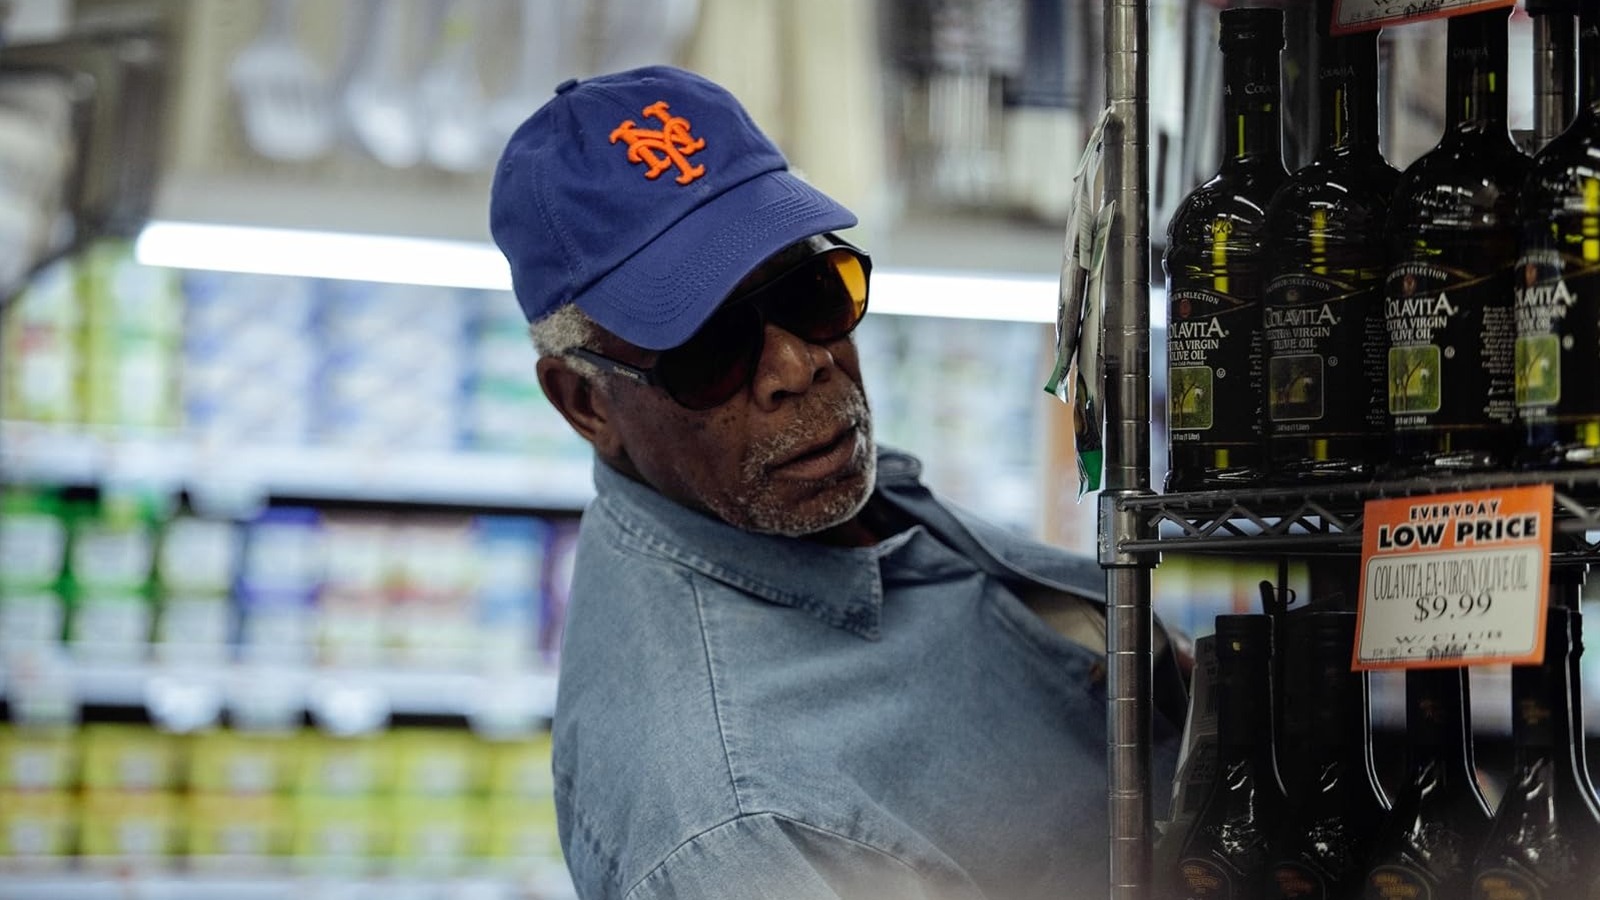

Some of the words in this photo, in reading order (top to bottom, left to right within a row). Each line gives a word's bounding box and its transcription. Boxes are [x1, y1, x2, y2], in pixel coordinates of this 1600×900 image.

[1183, 291, 1220, 305] SELECTION
[1385, 291, 1454, 320] COLAVITA
[1264, 304, 1337, 328] COLAVITA
[1410, 316, 1448, 329] VIRGIN
[1169, 316, 1226, 339] OLAVITA
[1292, 326, 1331, 338] VIRGIN
[1391, 329, 1413, 342] OLIVE
[1415, 328, 1434, 340] OIL
[1185, 339, 1219, 350] VIRGIN
[1298, 338, 1318, 349] OIL
[1190, 350, 1207, 360] OIL
[1411, 501, 1499, 519] EVERYDAY
[1379, 523, 1445, 549] LOW
[1456, 516, 1537, 542] PRICE
[1374, 563, 1425, 600] COLAVITA
[1479, 555, 1510, 593] OLIVE
[1511, 553, 1529, 591] OIL
[1414, 592, 1493, 622] $9.99
